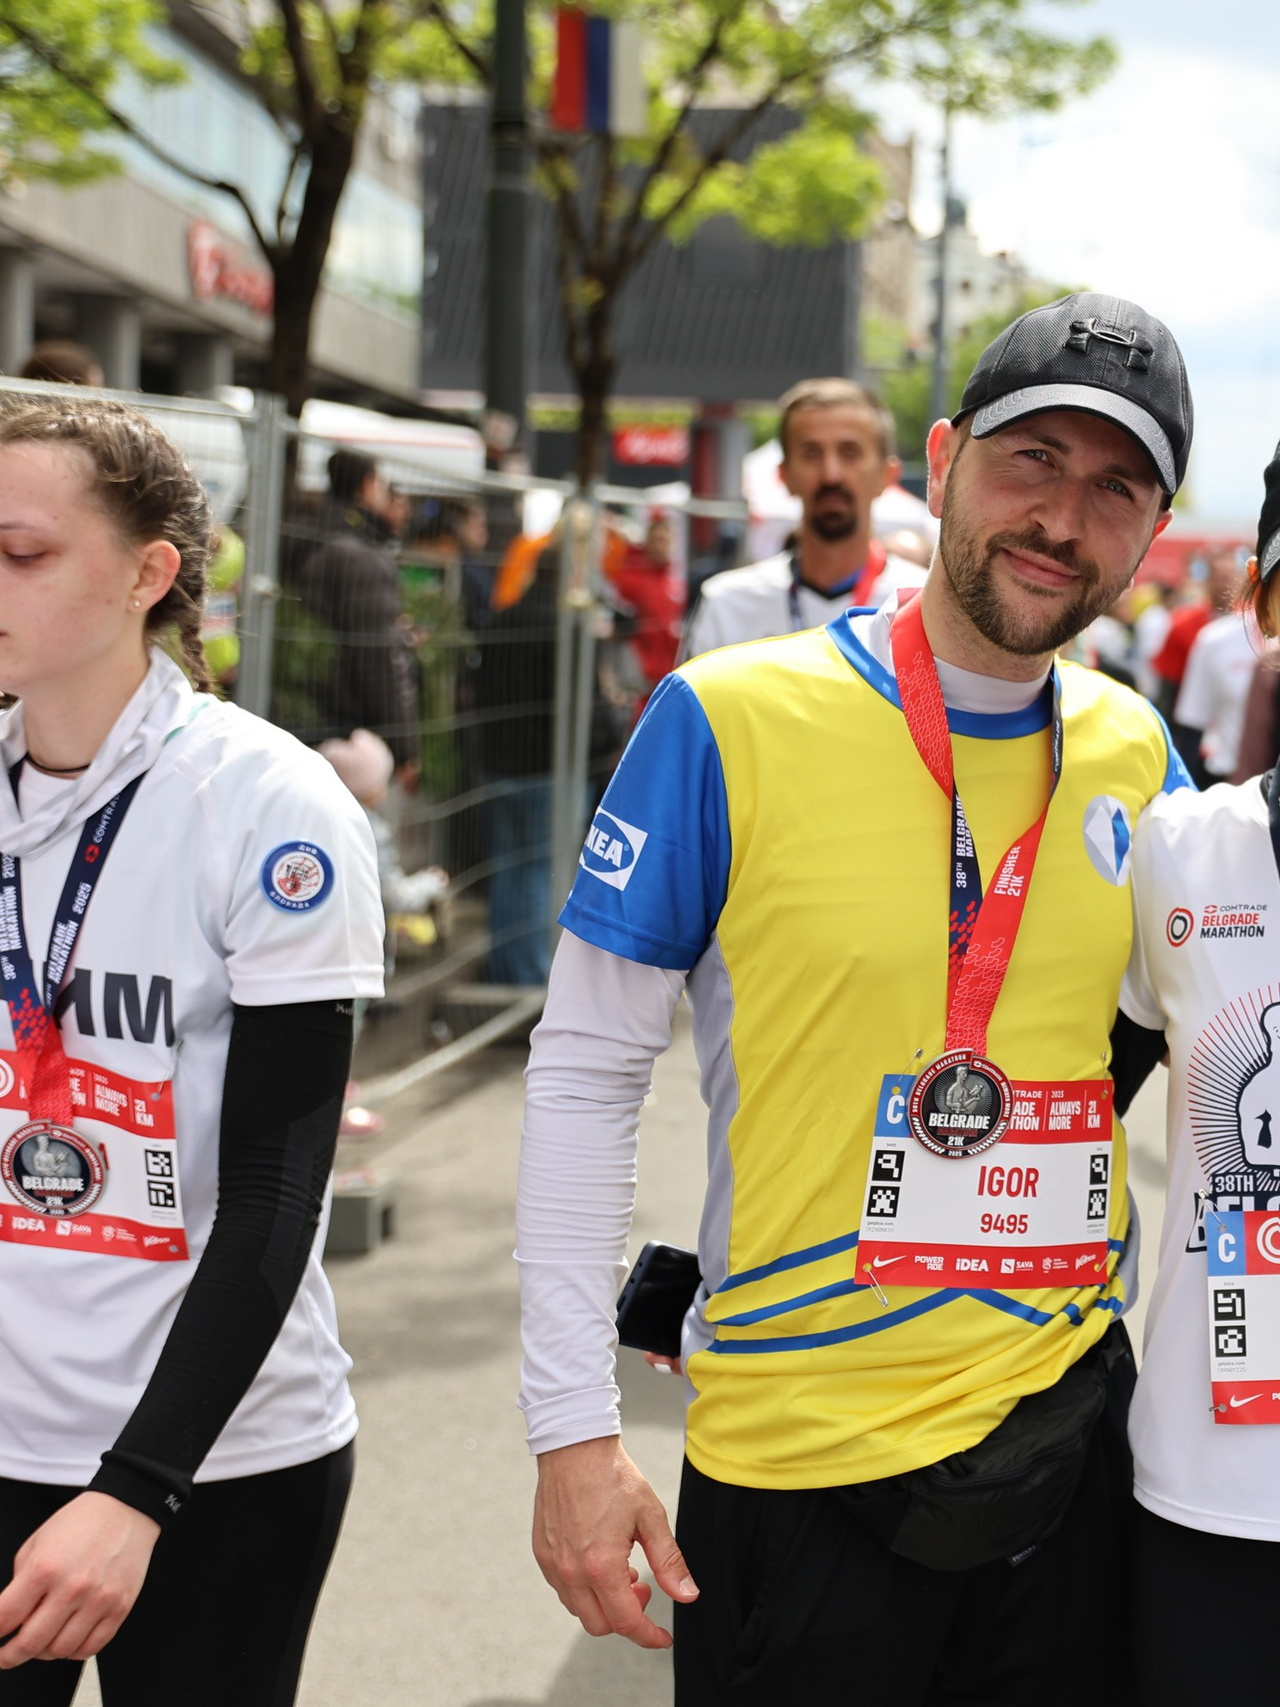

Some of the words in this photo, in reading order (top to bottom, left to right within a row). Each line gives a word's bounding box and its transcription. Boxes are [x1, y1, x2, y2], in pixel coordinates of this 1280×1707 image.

[584, 824, 624, 868] KEA
[956, 862, 967, 888] 38TH
[994, 845, 1021, 895] FINISHER
[1007, 875, 1025, 897] 21K
[73, 883, 92, 915] 2025
[1220, 904, 1268, 912] COMTRADE
[1202, 913, 1260, 927] BELGRADE
[1200, 926, 1265, 939] MARATHON
[95, 1083, 127, 1108] ALWAYS
[1051, 1091, 1064, 1099] 2025
[94, 1097, 120, 1116] MORE
[135, 1113, 154, 1127] KM
[1050, 1100, 1081, 1116] ALWAYS
[1088, 1100, 1097, 1114] 21
[928, 1112, 991, 1130] BELGRADE
[1048, 1116, 1071, 1130] MORE
[1087, 1114, 1101, 1129] KM
[947, 1136, 965, 1147] 21K
[22, 1176, 84, 1192] BELGRADE
[977, 1166, 1040, 1198] IGOR
[1215, 1174, 1254, 1193] 38TH
[980, 1213, 1029, 1234] 9495
[1218, 1233, 1236, 1263] C
[915, 1255, 944, 1264] POWER
